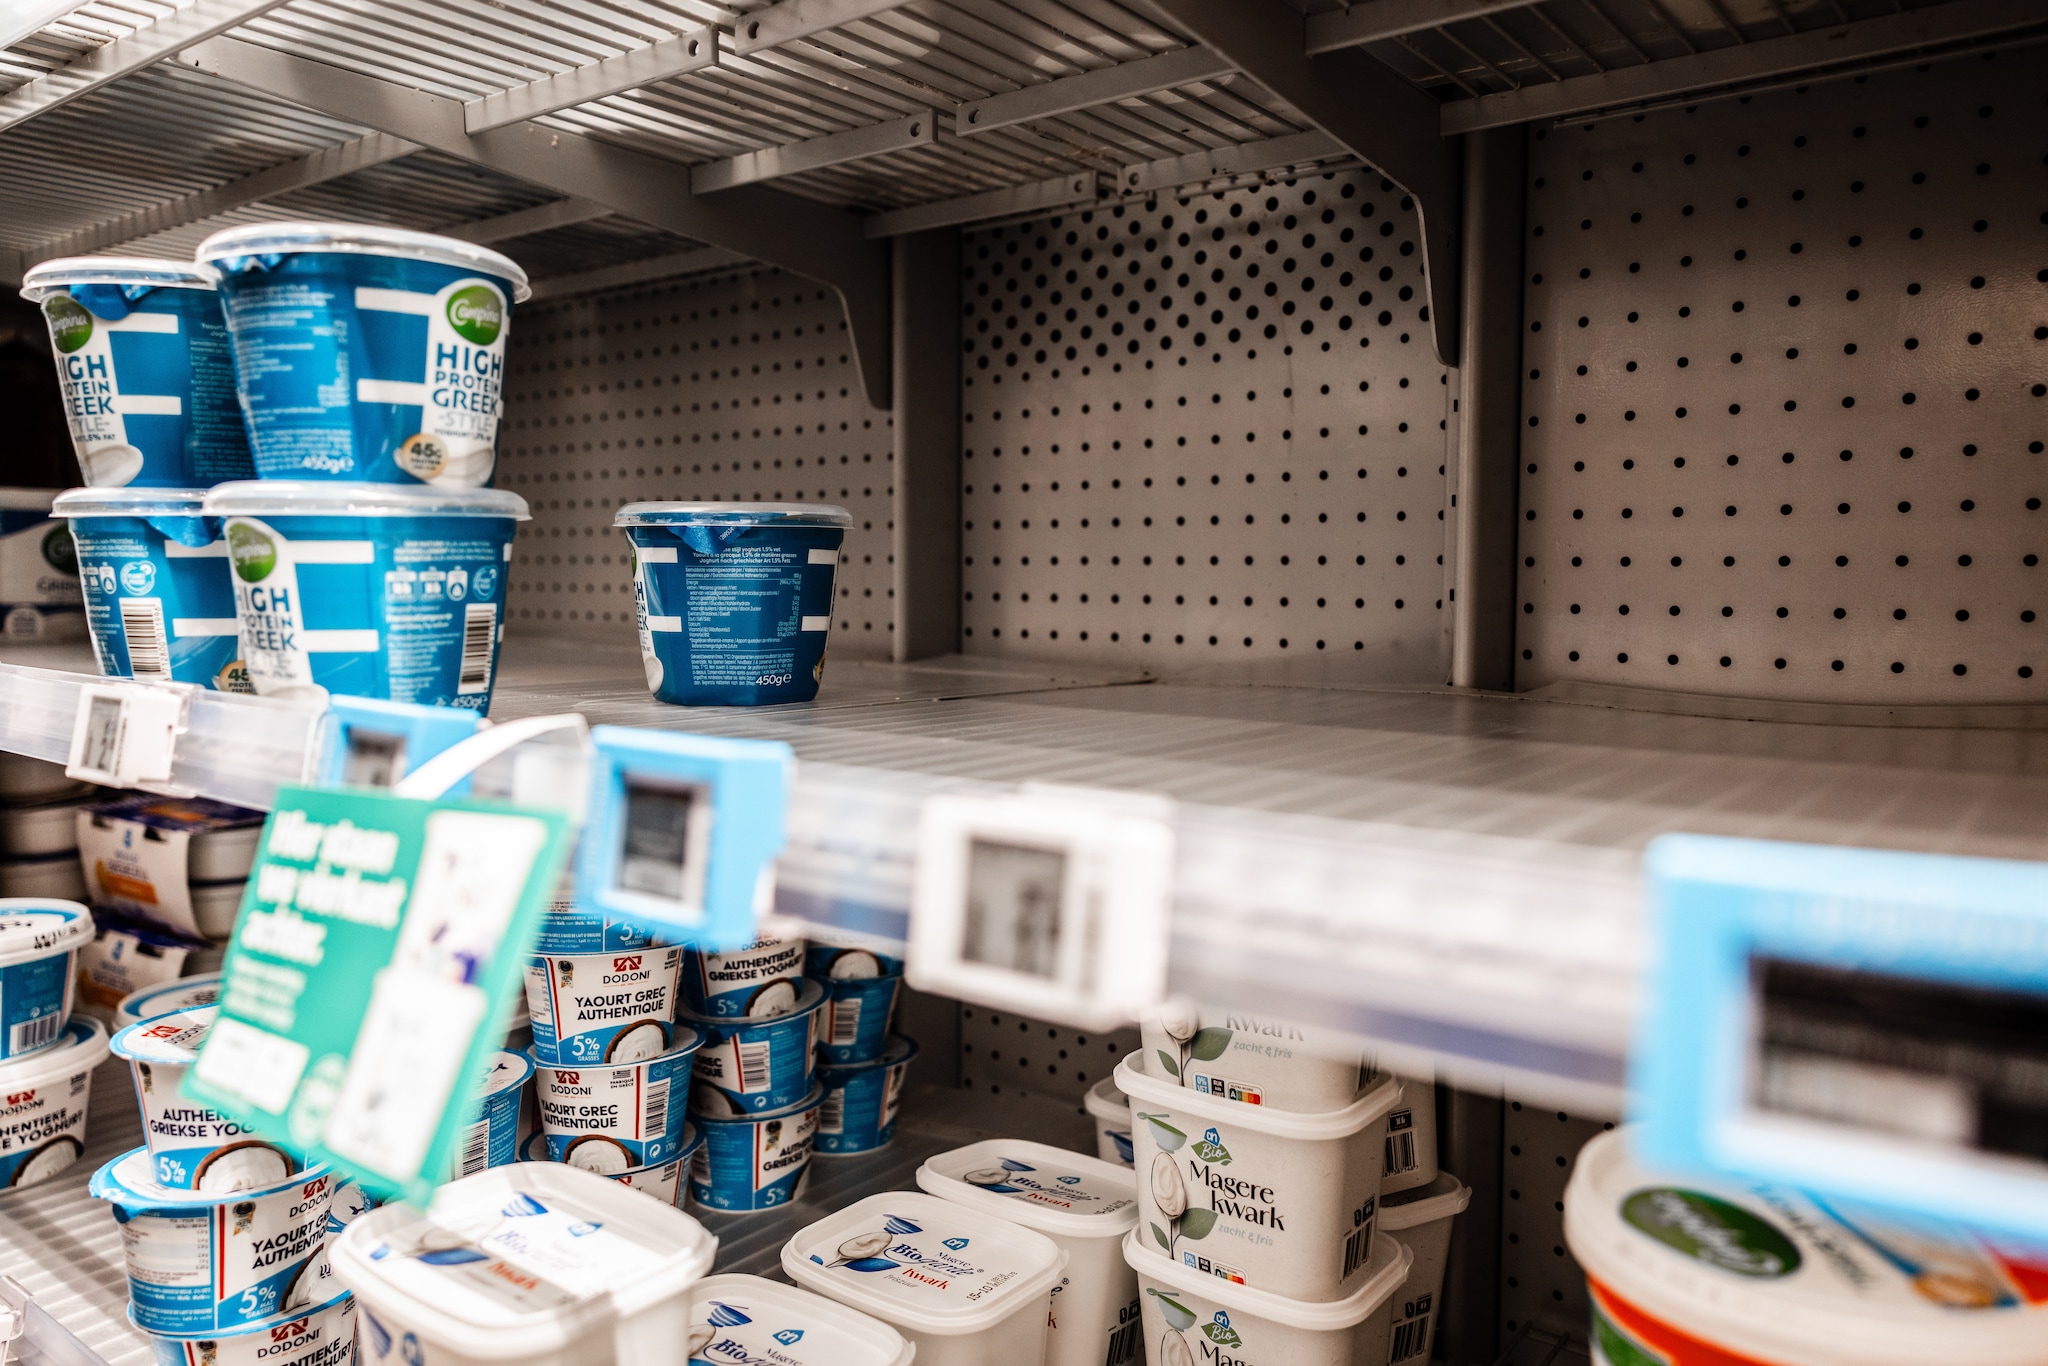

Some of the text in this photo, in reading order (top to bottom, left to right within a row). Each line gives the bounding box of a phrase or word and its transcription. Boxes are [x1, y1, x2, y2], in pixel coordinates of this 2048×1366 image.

[427, 342, 502, 380] HIGH
[425, 370, 500, 396] PROTEIN
[422, 387, 498, 417] GREEK
[620, 920, 645, 942] 5%
[624, 938, 645, 947] GRASSES
[723, 947, 796, 971] AUTHENTIEKE
[603, 970, 651, 985] DODONI
[709, 969, 758, 982] GRIEKSE
[575, 985, 667, 1008] YAOURT GREC
[577, 998, 664, 1021] AUTHENTIQUE
[571, 1035, 600, 1057] 5%
[1233, 1041, 1293, 1059] zacht & fris
[551, 1083, 592, 1096] DODONI
[544, 1113, 619, 1130] AUTHENTIQUE
[579, 1104, 619, 1117] GREC
[150, 1119, 208, 1138] GRIEKSE
[1200, 1143, 1226, 1159] Bio
[159, 1156, 187, 1183] 5%
[1189, 1159, 1275, 1205] Magere
[1211, 1189, 1285, 1232] kwark
[252, 1221, 314, 1254] YAOURT
[1218, 1224, 1274, 1247] zacht & fris
[935, 1251, 971, 1268] Magere
[238, 1284, 277, 1315] 5%
[966, 1284, 994, 1301] 15-10
[245, 1304, 275, 1319] GRASSES
[257, 1327, 320, 1359] DODONI
[1211, 1325, 1236, 1341] Bio
